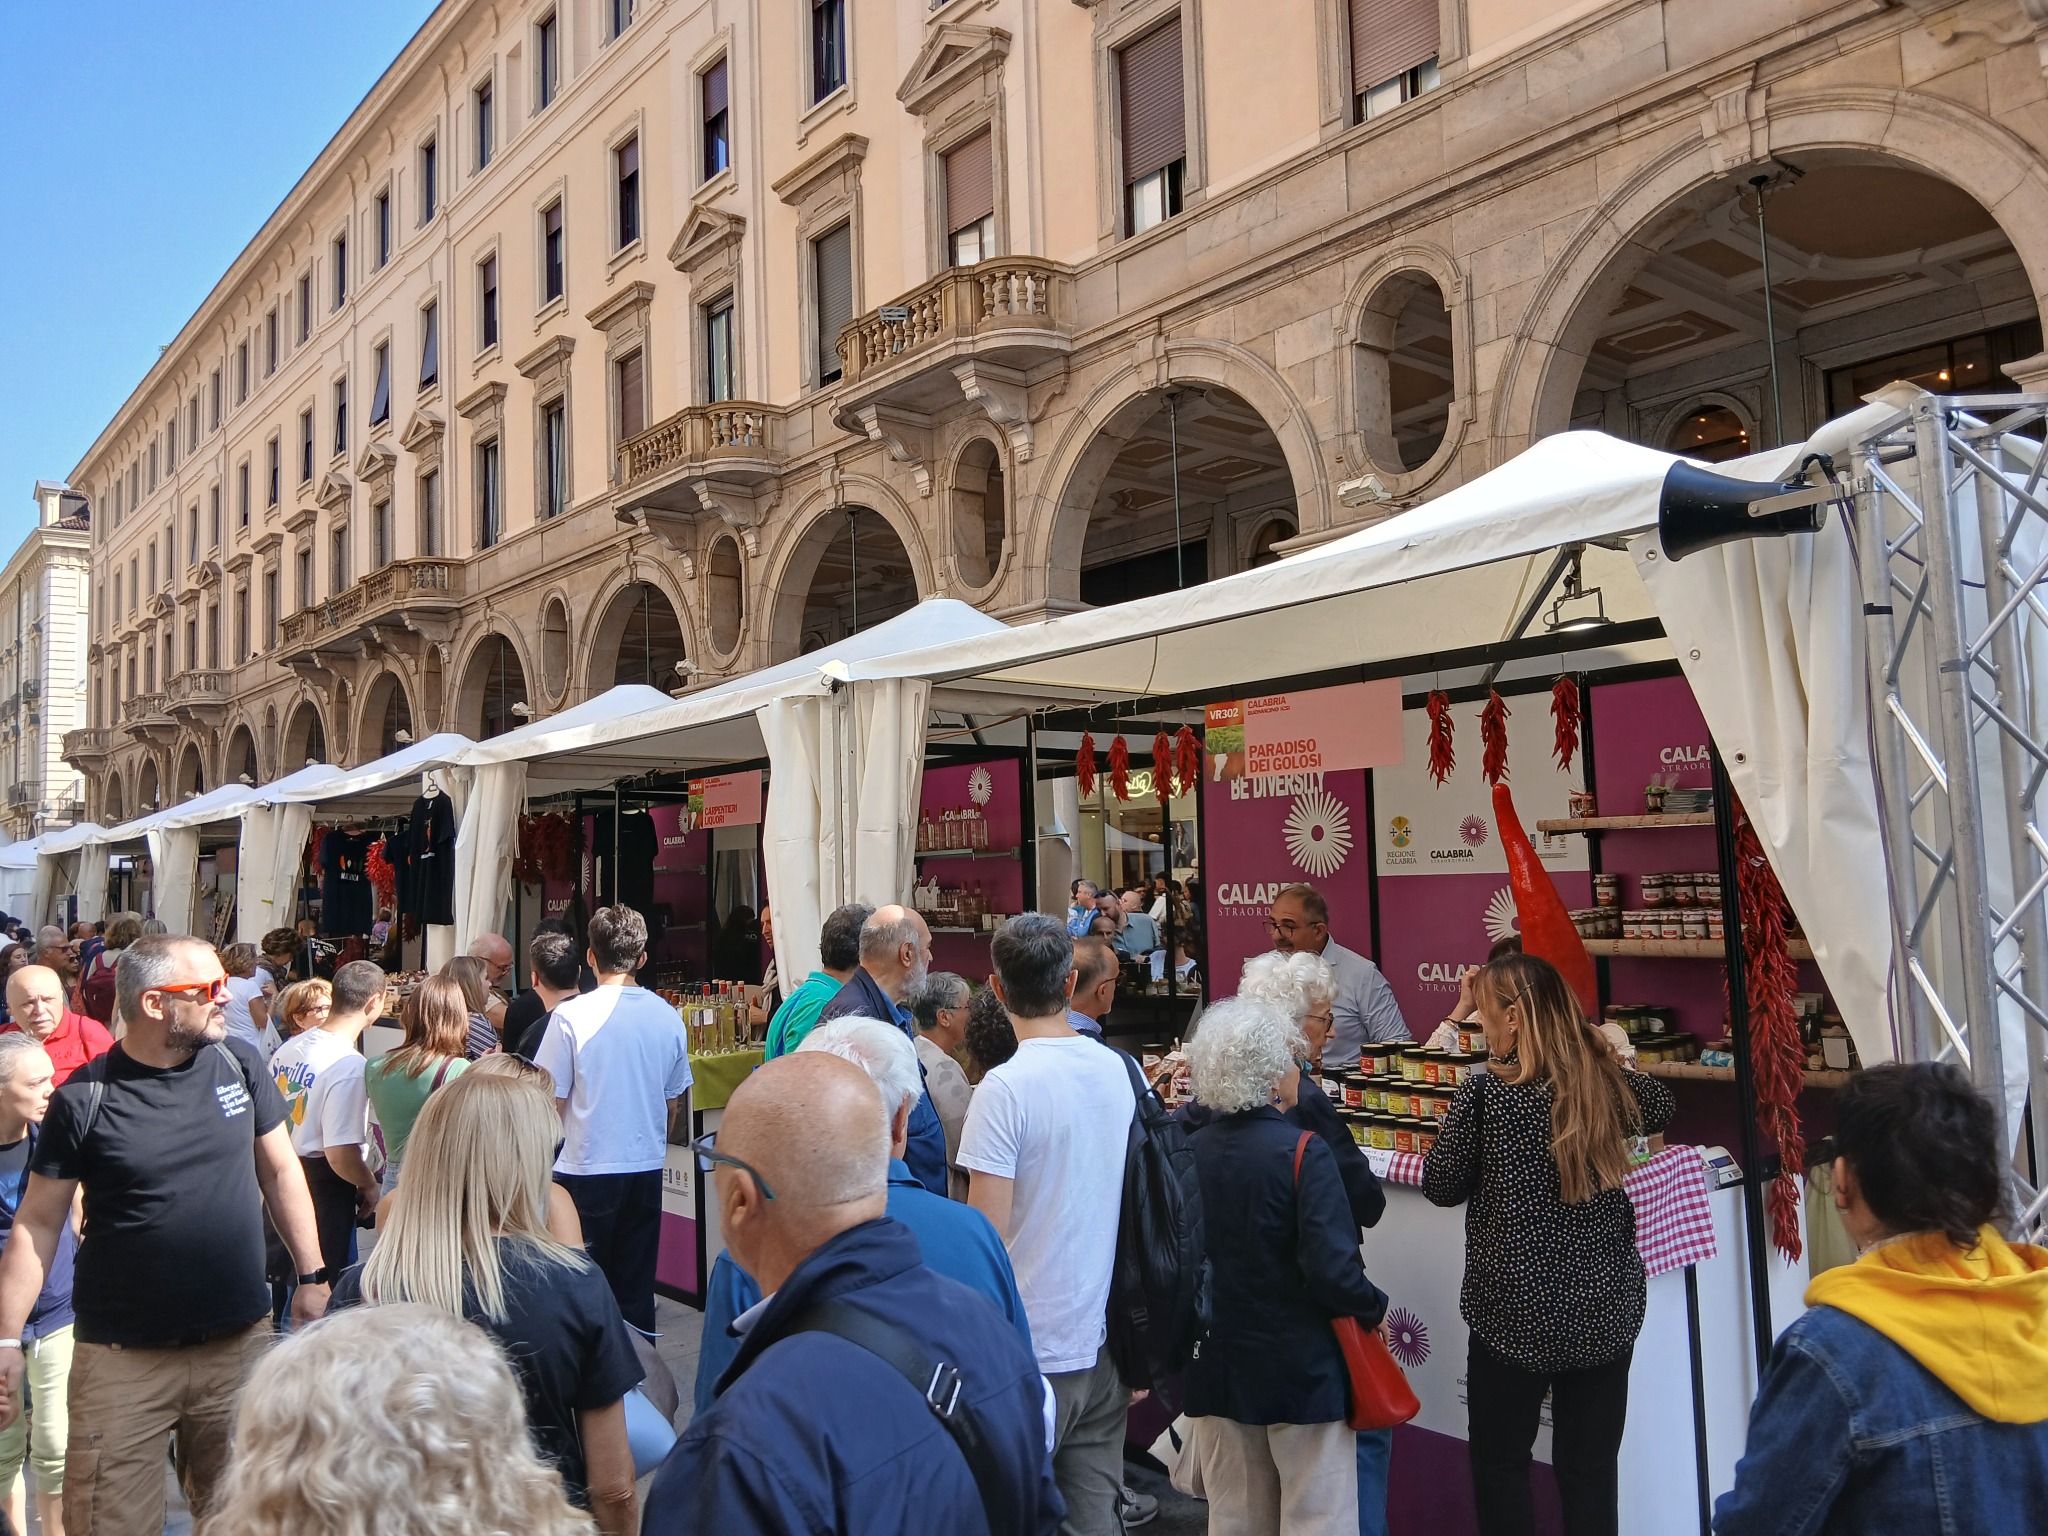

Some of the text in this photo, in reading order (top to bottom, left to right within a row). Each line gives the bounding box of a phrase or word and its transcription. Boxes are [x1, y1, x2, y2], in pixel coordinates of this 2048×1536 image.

[1248, 697, 1286, 708] CALABRIA
[1209, 707, 1239, 720] VR302
[1249, 738, 1317, 759] PARADISO
[1660, 744, 1710, 764] CALA
[1249, 753, 1322, 773] DEI GOLOSI
[1230, 776, 1250, 800] BE
[704, 804, 738, 816] CARPENTIERI
[704, 815, 725, 825] LIQUORI
[1386, 850, 1416, 858] REGIONE
[1430, 849, 1474, 859] CALABRIA
[272, 1058, 315, 1088] Sevilla
